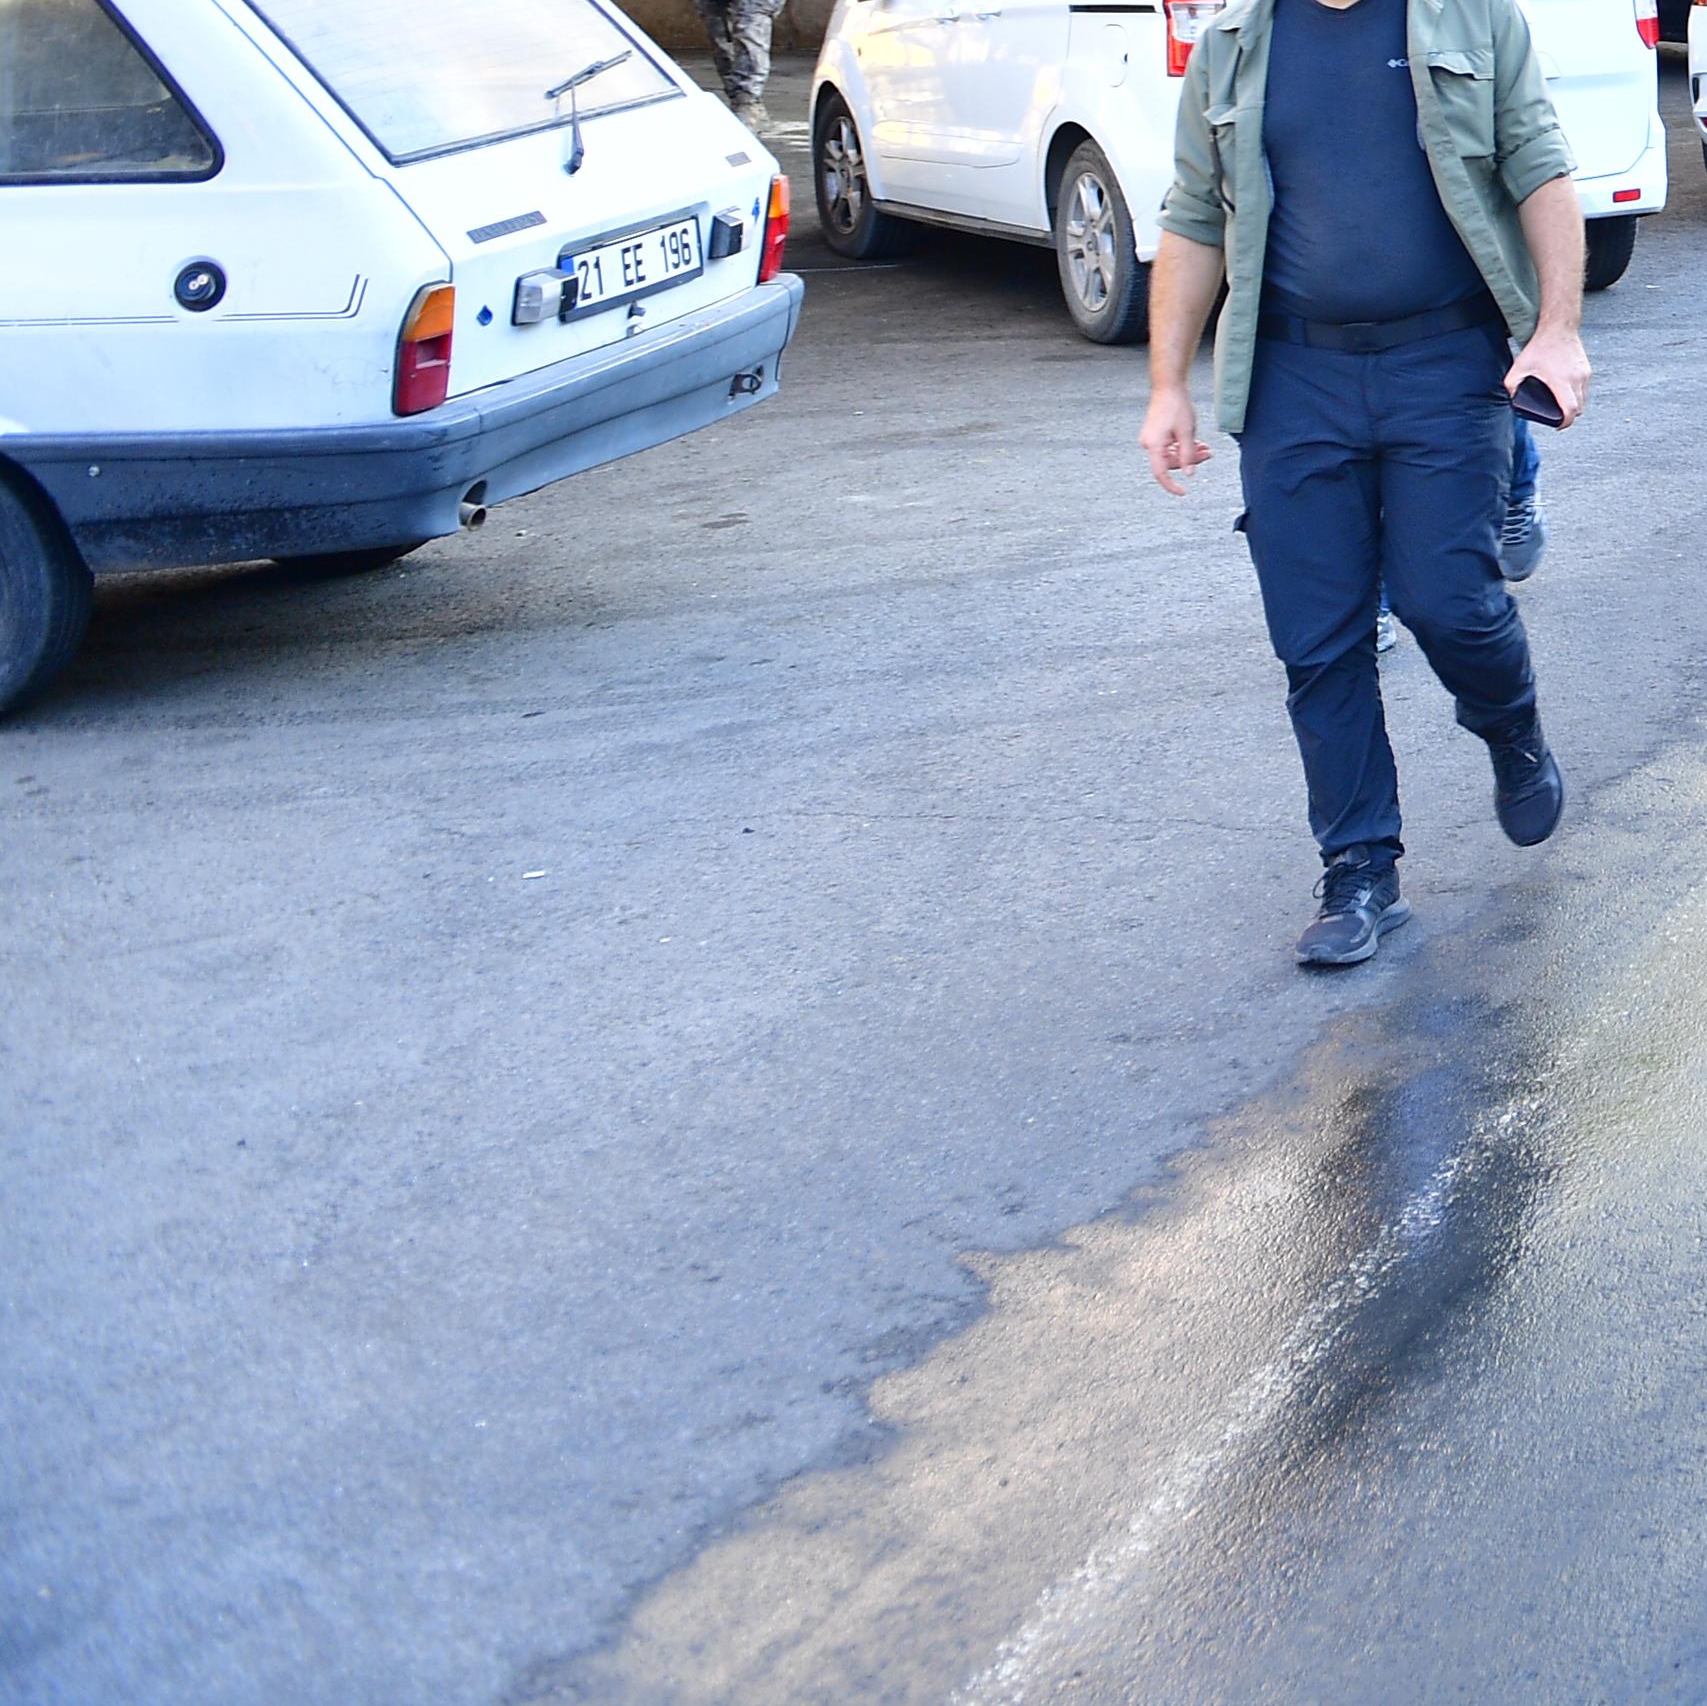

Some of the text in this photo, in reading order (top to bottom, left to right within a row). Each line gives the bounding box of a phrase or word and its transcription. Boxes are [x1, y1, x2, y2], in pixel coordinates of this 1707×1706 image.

[578, 227, 692, 301] 21 EE 196
